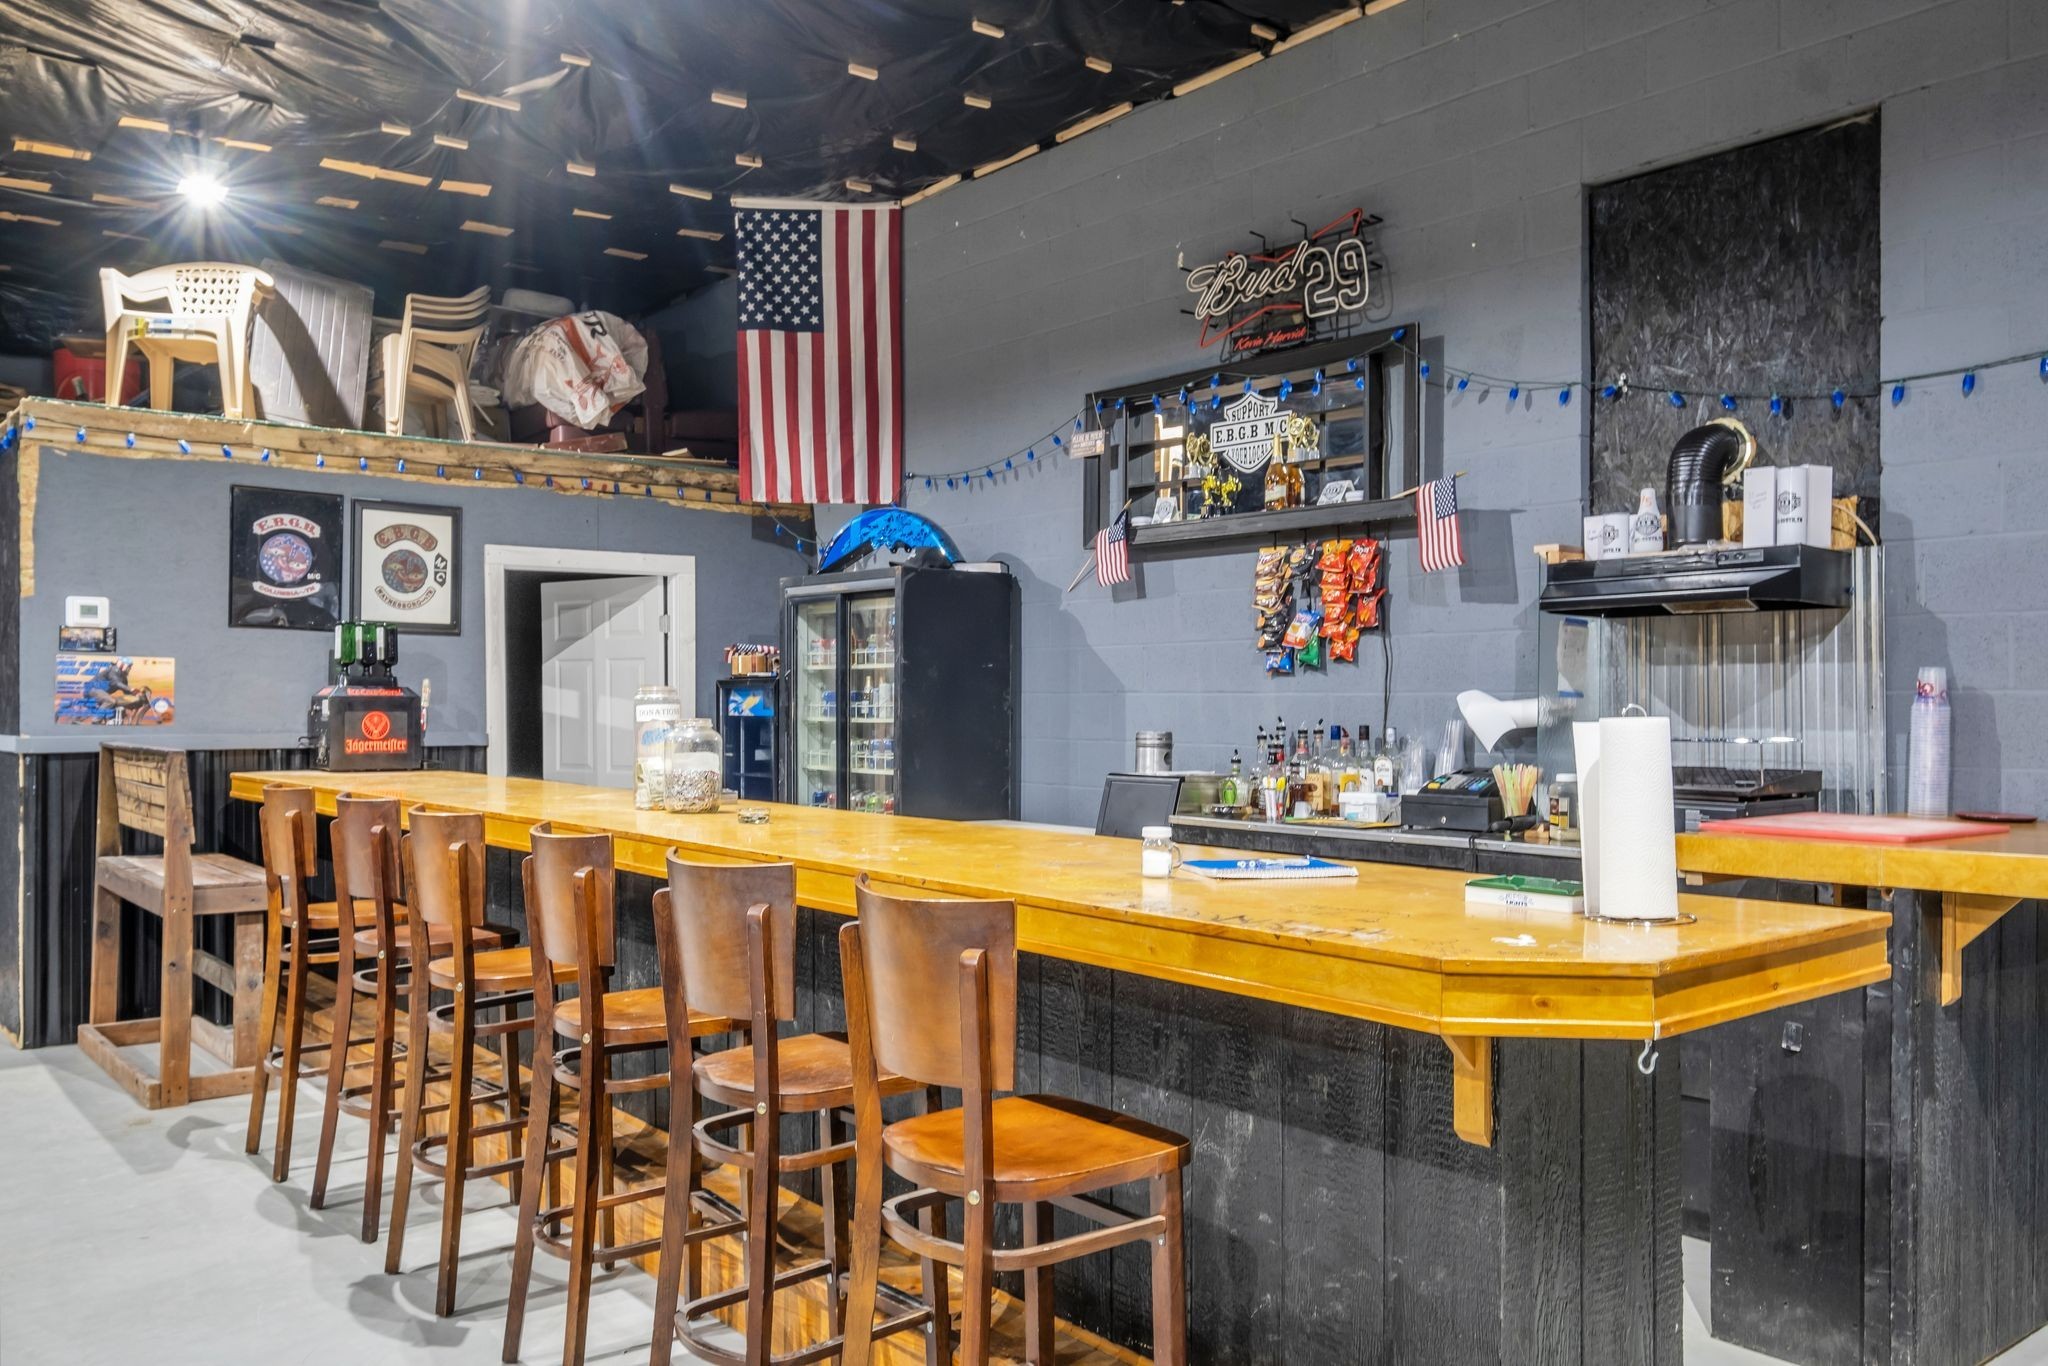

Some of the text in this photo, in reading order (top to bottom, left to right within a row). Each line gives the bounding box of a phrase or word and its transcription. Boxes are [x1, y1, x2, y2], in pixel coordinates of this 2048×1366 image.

[1186, 238, 1369, 320] Bud 29
[1231, 400, 1269, 422] SUPPORT
[434, 556, 447, 569] M
[435, 572, 446, 581] C
[345, 738, 407, 755] Jägermeister
